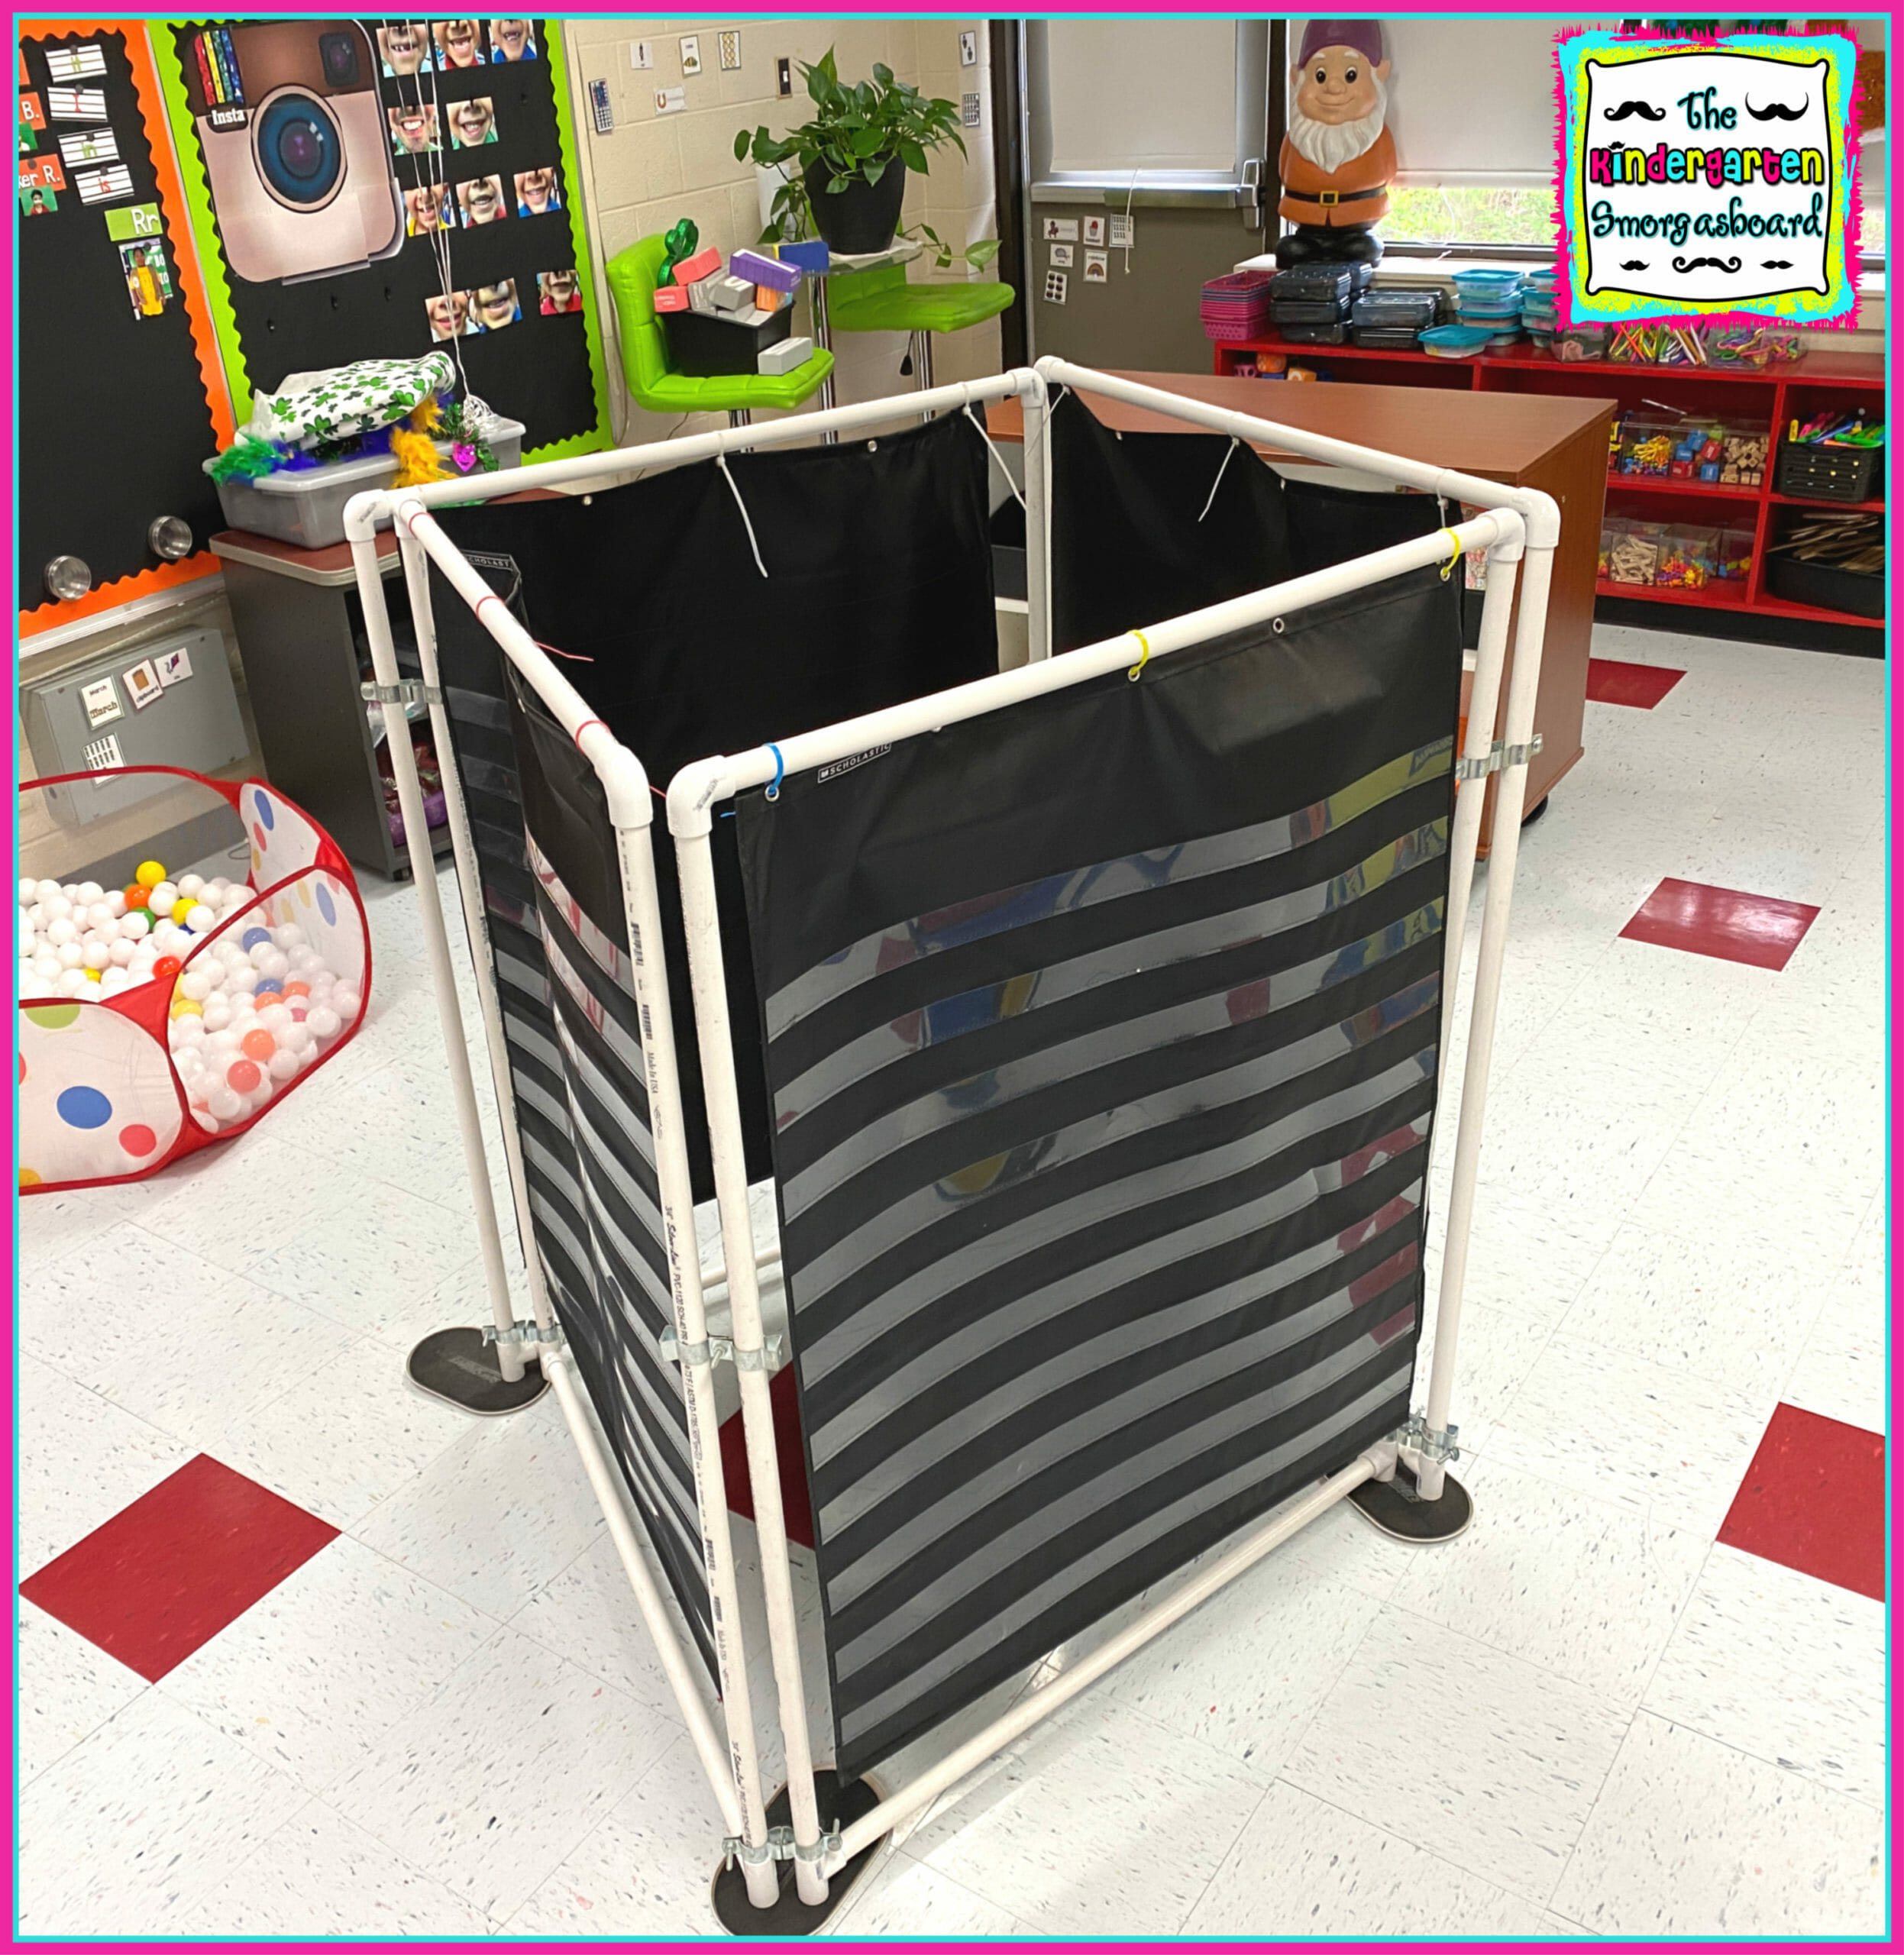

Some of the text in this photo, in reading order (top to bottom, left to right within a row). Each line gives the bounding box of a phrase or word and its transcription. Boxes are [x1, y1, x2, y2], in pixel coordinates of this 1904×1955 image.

[21, 101, 40, 120] B.
[212, 108, 245, 125] Insta
[43, 165, 60, 183] R.
[98, 178, 112, 193] is
[131, 208, 158, 234] Rr
[830, 744, 889, 775] SCHOLASTIC
